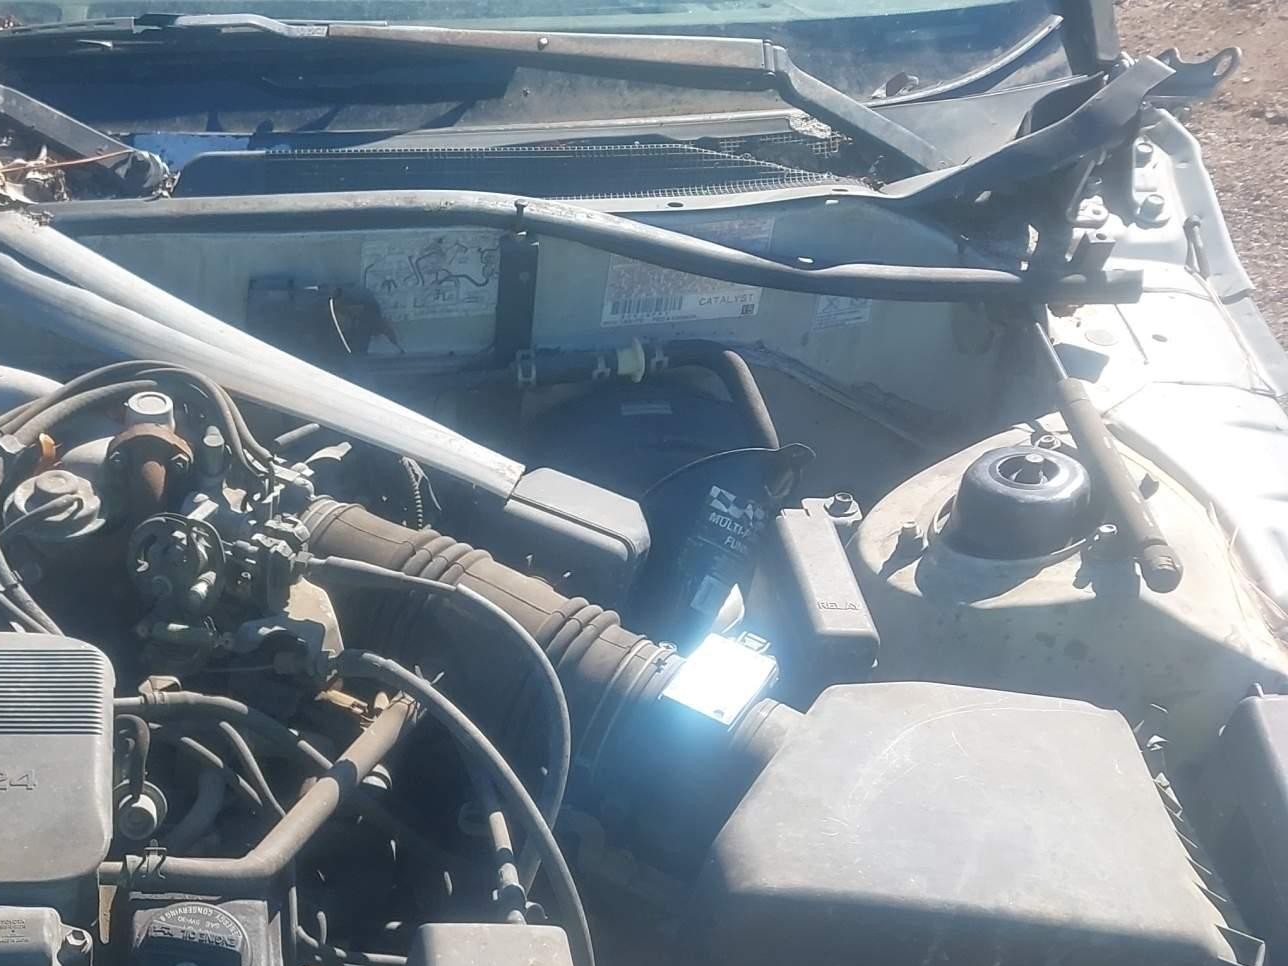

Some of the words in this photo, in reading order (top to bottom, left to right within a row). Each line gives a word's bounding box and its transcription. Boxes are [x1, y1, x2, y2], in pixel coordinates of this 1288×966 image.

[698, 293, 753, 306] CATALYST
[817, 600, 860, 611] RELAY
[165, 905, 213, 920] CONSERVING
